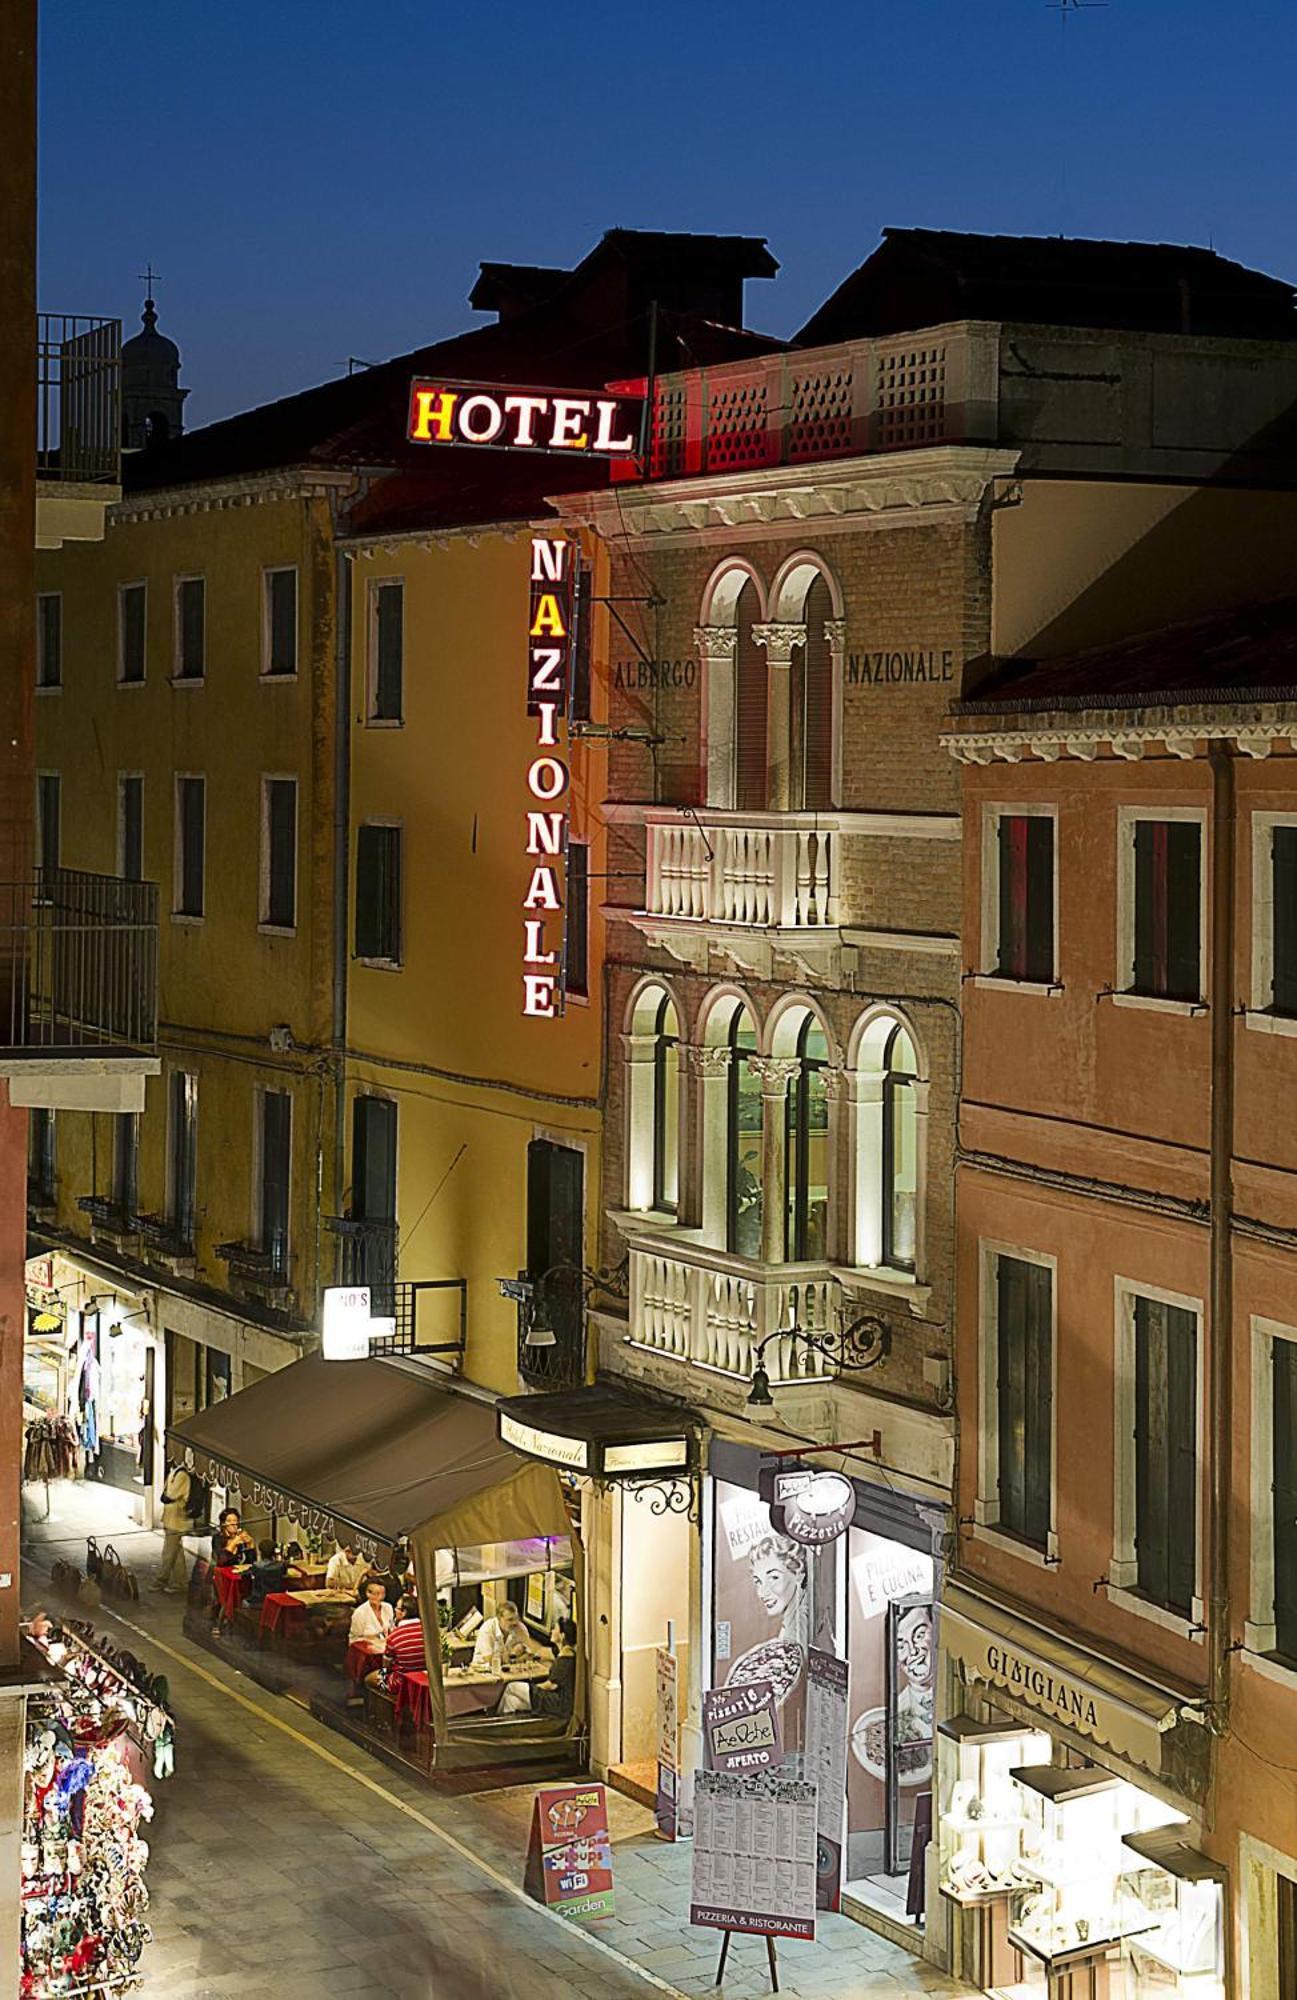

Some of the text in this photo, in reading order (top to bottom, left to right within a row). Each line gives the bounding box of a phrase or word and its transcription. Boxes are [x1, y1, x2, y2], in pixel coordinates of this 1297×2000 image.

[412, 391, 633, 451] HOTEL
[614, 650, 954, 690] ALBERGO NAZIONALE
[522, 538, 567, 1018] NAZIONALE
[253, 1481, 285, 1517] PASTA
[301, 1503, 336, 1539] PIZZA
[787, 1511, 845, 1539] Pizzeria
[867, 1562, 925, 1602] E CUCINA
[726, 1751, 770, 1769] APERTO
[555, 1898, 606, 1917] Garden
[696, 1910, 809, 1934] PIZZERIA & RISTORANTE
